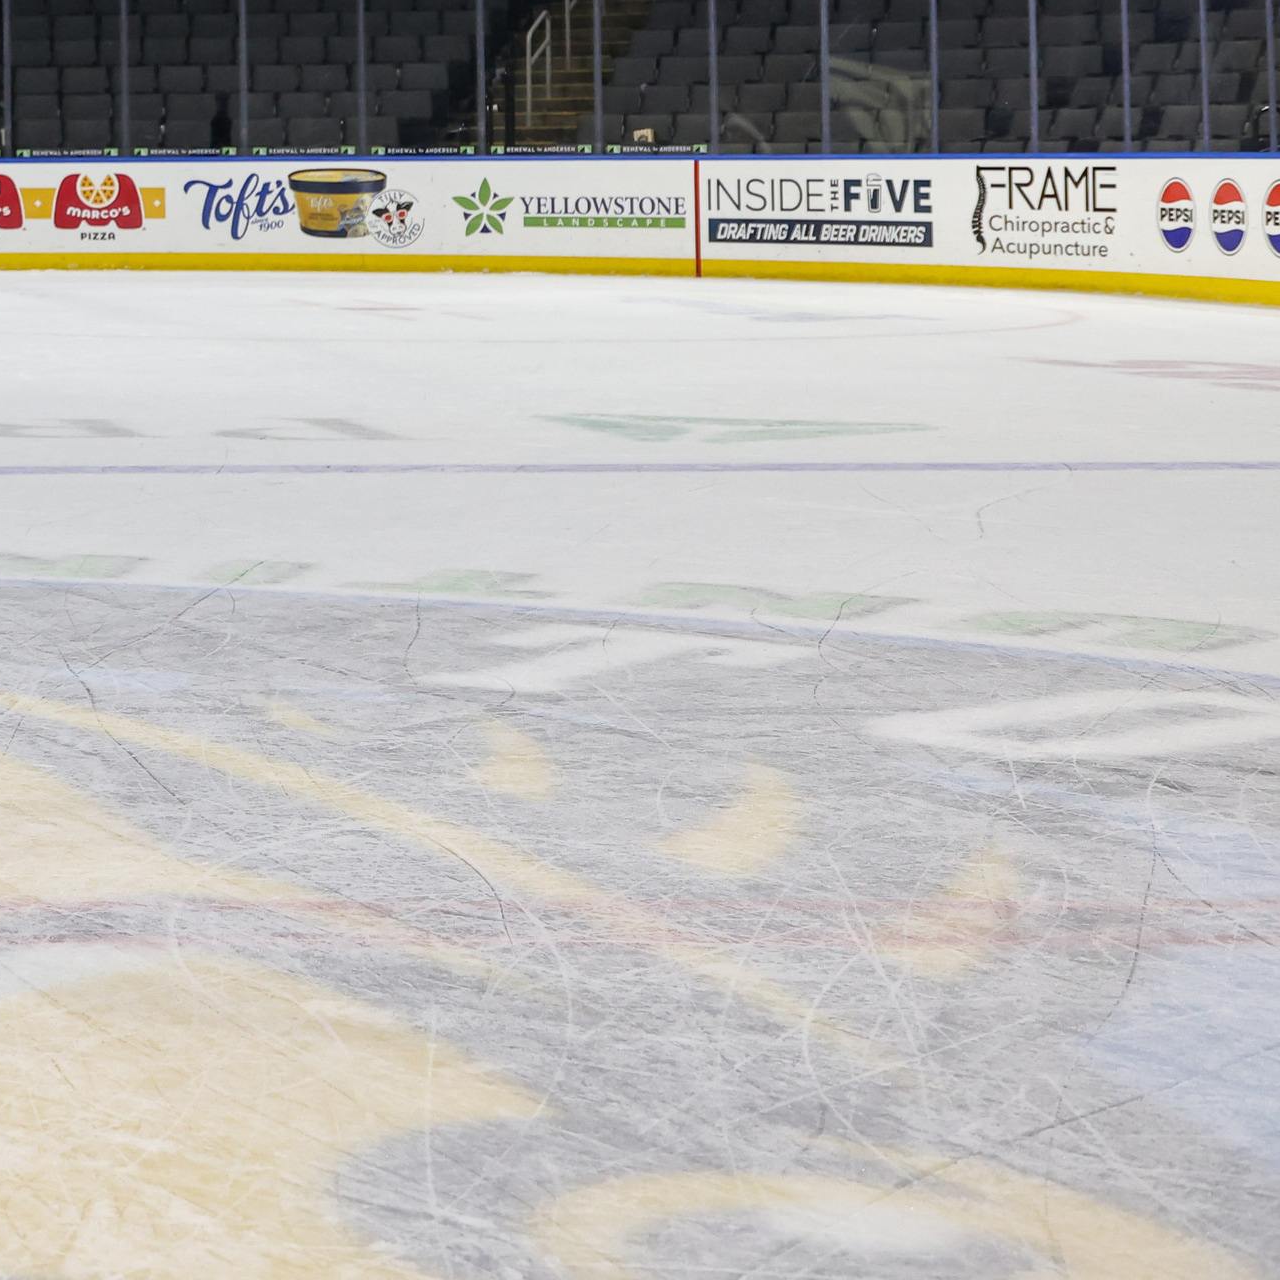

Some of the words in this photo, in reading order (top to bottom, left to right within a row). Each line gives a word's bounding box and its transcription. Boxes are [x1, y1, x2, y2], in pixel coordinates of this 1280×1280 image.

[378, 191, 404, 202] TILLY
[707, 178, 826, 212] INSIDE
[830, 178, 839, 212] THE
[975, 165, 1117, 213] FRAME
[66, 205, 131, 220] MARCO'S
[183, 173, 295, 240] Toft's
[520, 196, 687, 216] YELLOWSTONE
[1160, 207, 1193, 223] PEPSI
[259, 220, 284, 232] 1900
[543, 217, 667, 228] LANDSCAPE
[988, 214, 1102, 237] Chiropractic
[1104, 216, 1115, 235] &
[1212, 209, 1245, 226] PEPSI
[80, 232, 116, 241] PIZZA
[375, 222, 421, 245] APPROVED
[716, 222, 788, 241] DRAFTING
[790, 223, 818, 241] ALL
[820, 223, 855, 242] BEER
[858, 224, 927, 244] DRINKERS
[991, 237, 1108, 258] Acupuncture
